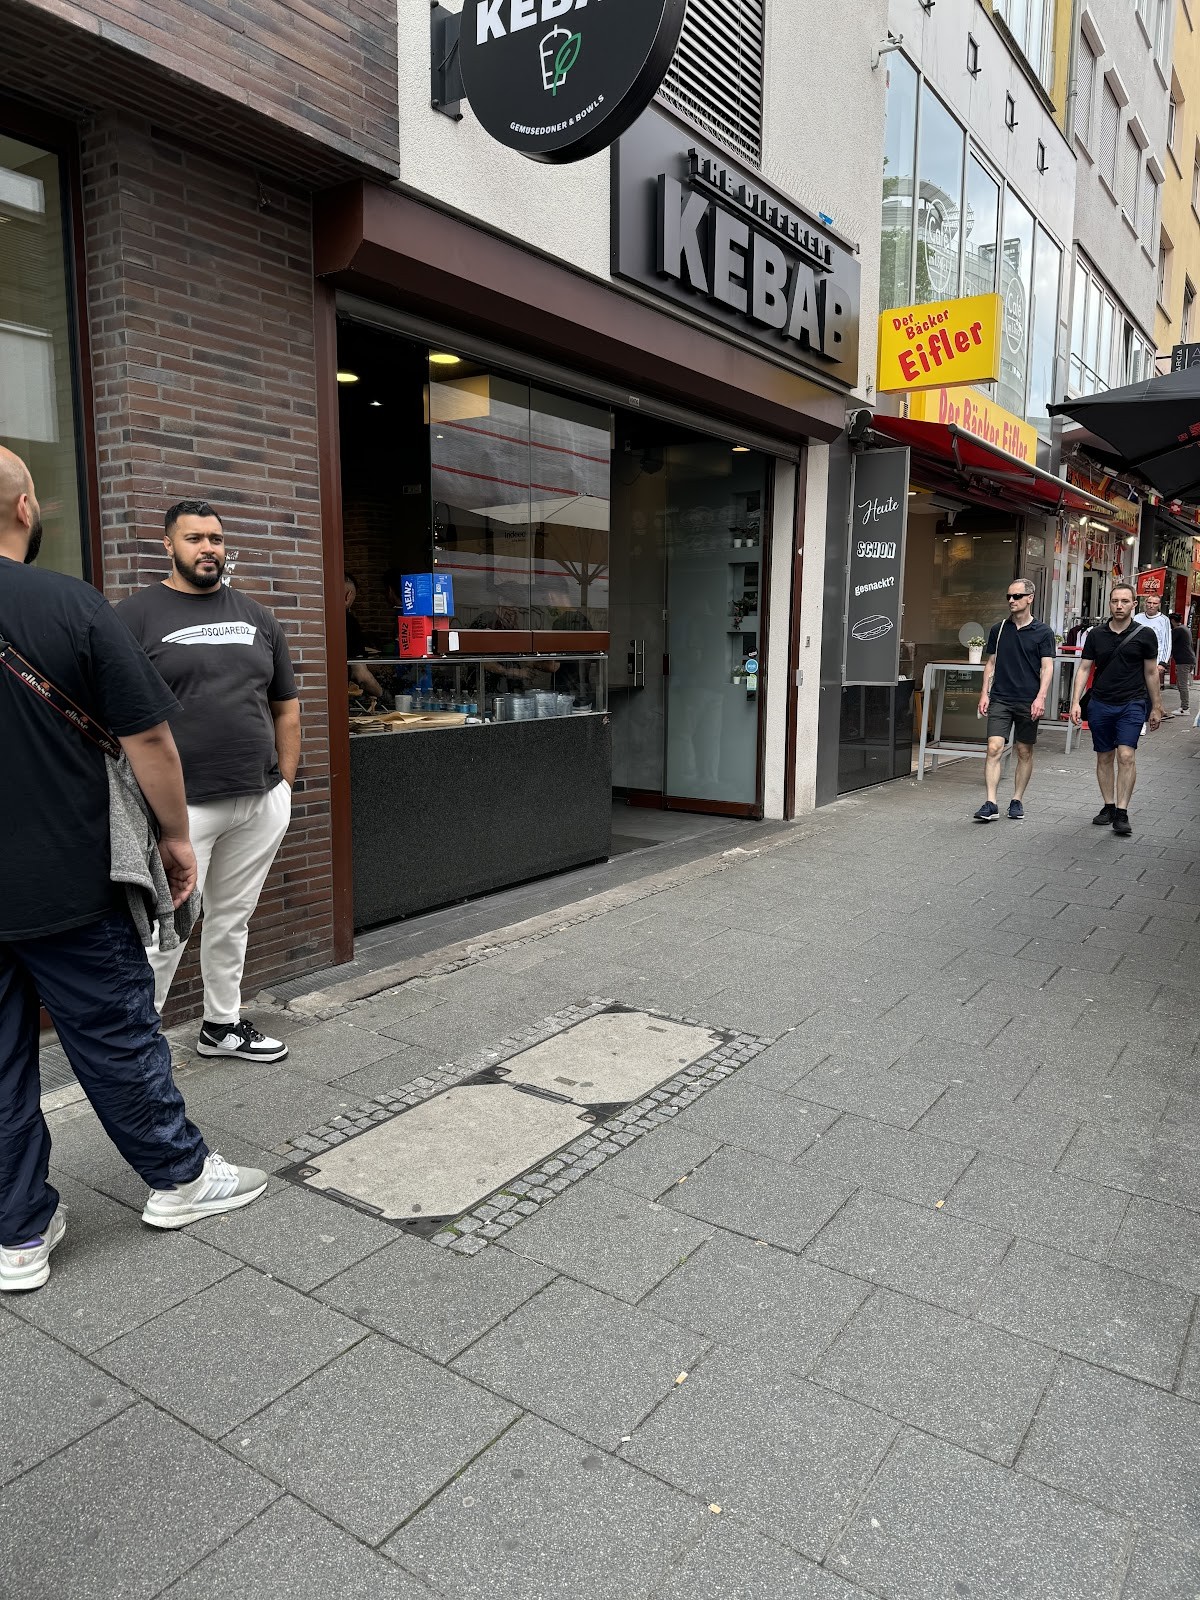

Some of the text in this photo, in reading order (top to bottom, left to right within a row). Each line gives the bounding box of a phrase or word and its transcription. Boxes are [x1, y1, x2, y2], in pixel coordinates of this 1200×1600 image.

[568, 118, 575, 126] &
[575, 94, 604, 122] BOWLS
[688, 148, 835, 265] THE DIFFERENT
[657, 173, 851, 363] KEBAB
[892, 313, 914, 331] Der
[905, 309, 949, 340] Bäcker
[898, 321, 982, 382] Eifler
[939, 387, 1028, 461] Der Bäcker Eifler
[857, 496, 899, 526] Heute
[856, 541, 897, 559] SCHON
[404, 580, 414, 611] HEINZ
[854, 576, 895, 596] gesnackt?
[201, 625, 250, 637] DSQUARED2
[401, 622, 409, 651] HEINZ
[20, 671, 52, 698] ellesse
[65, 709, 89, 730] ellesse
